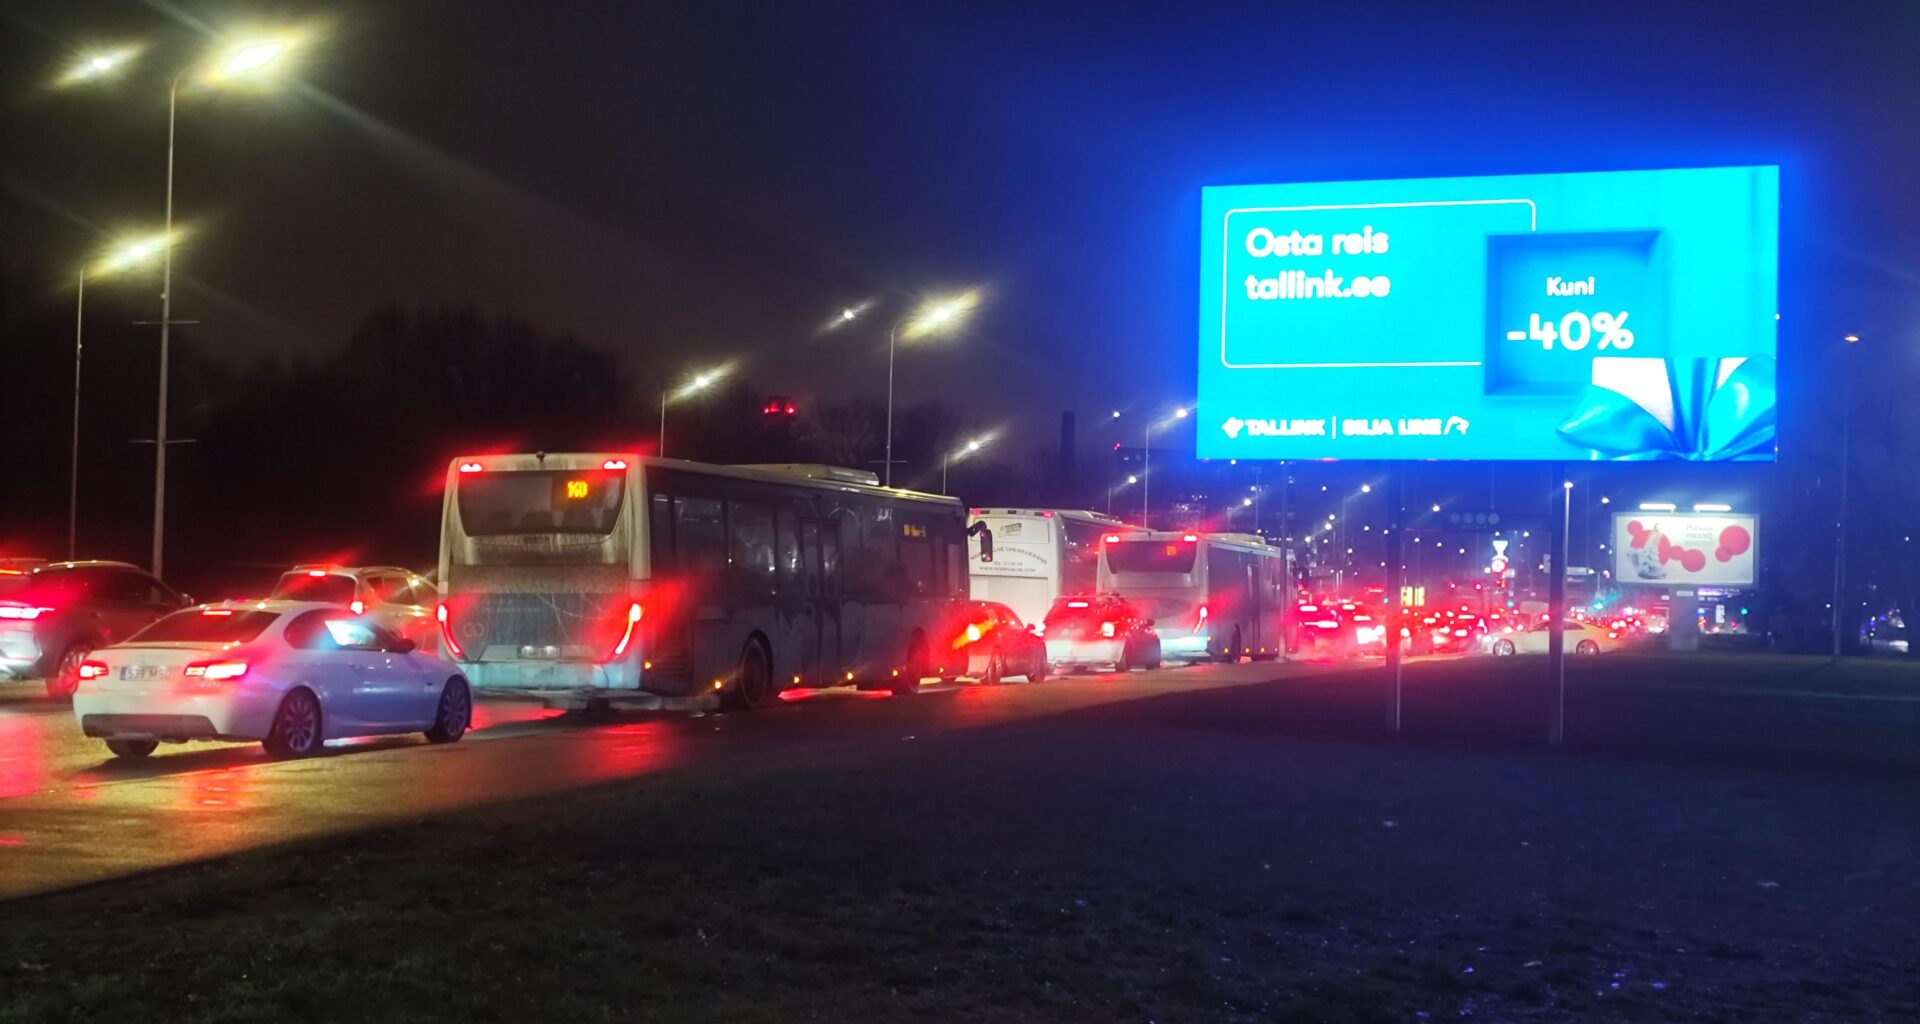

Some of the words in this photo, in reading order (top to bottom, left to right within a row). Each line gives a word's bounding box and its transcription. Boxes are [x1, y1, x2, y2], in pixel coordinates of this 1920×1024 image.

[1245, 227, 1323, 258] Osta
[1331, 224, 1389, 255] reis
[1244, 268, 1391, 300] tallink.ee
[1546, 276, 1595, 296] Kuni
[1507, 311, 1634, 351] -40%
[1245, 419, 1326, 436] TALLINK
